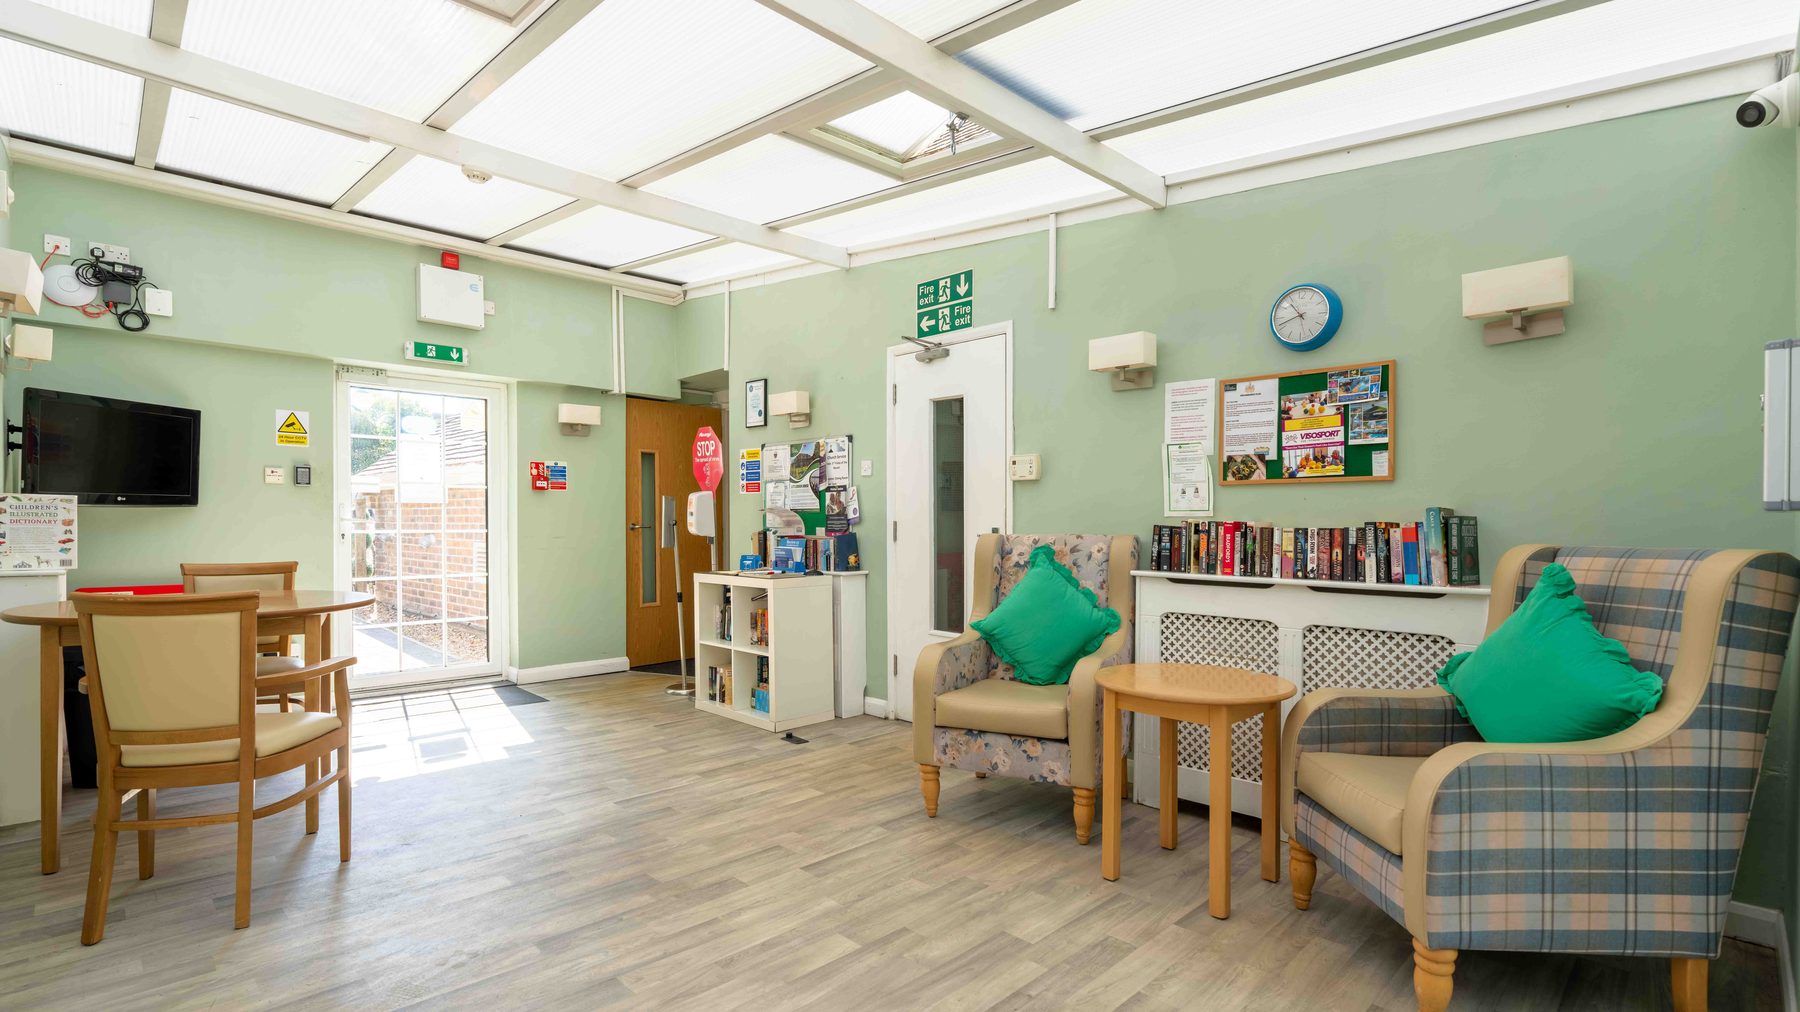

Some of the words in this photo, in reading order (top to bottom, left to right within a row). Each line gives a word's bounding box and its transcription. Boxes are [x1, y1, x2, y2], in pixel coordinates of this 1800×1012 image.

[920, 285, 934, 296] Fire
[920, 294, 934, 306] exit
[954, 306, 970, 316] Fire
[955, 314, 970, 326] exit
[1300, 430, 1341, 440] VISOSPORT
[696, 440, 716, 456] STOP
